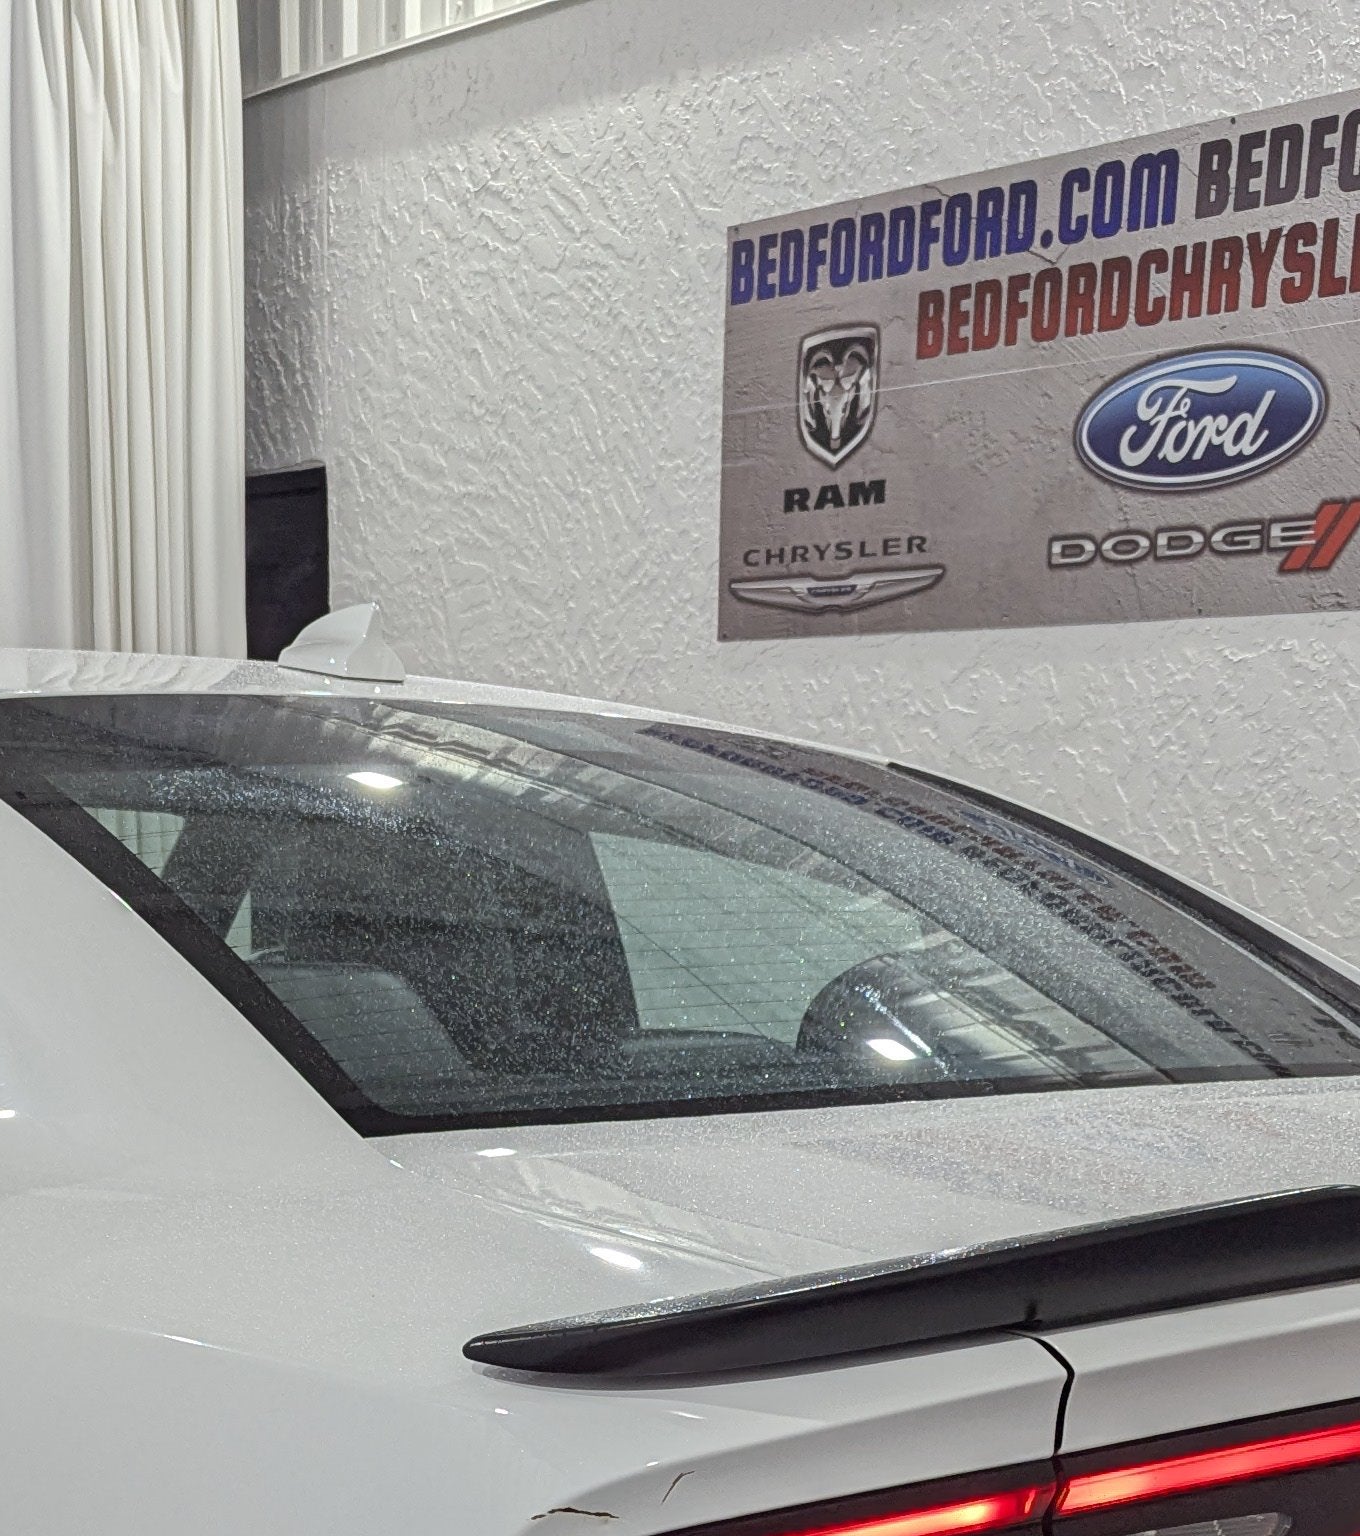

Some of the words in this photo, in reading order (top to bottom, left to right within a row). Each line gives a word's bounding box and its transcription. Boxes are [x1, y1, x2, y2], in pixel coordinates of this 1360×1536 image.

[731, 148, 1181, 305] BEDFORDFORD.COM
[1118, 375, 1277, 468] Ford
[783, 479, 887, 513] RAM
[742, 535, 928, 568] CHRYSLER
[1049, 519, 1318, 568] DODGE
